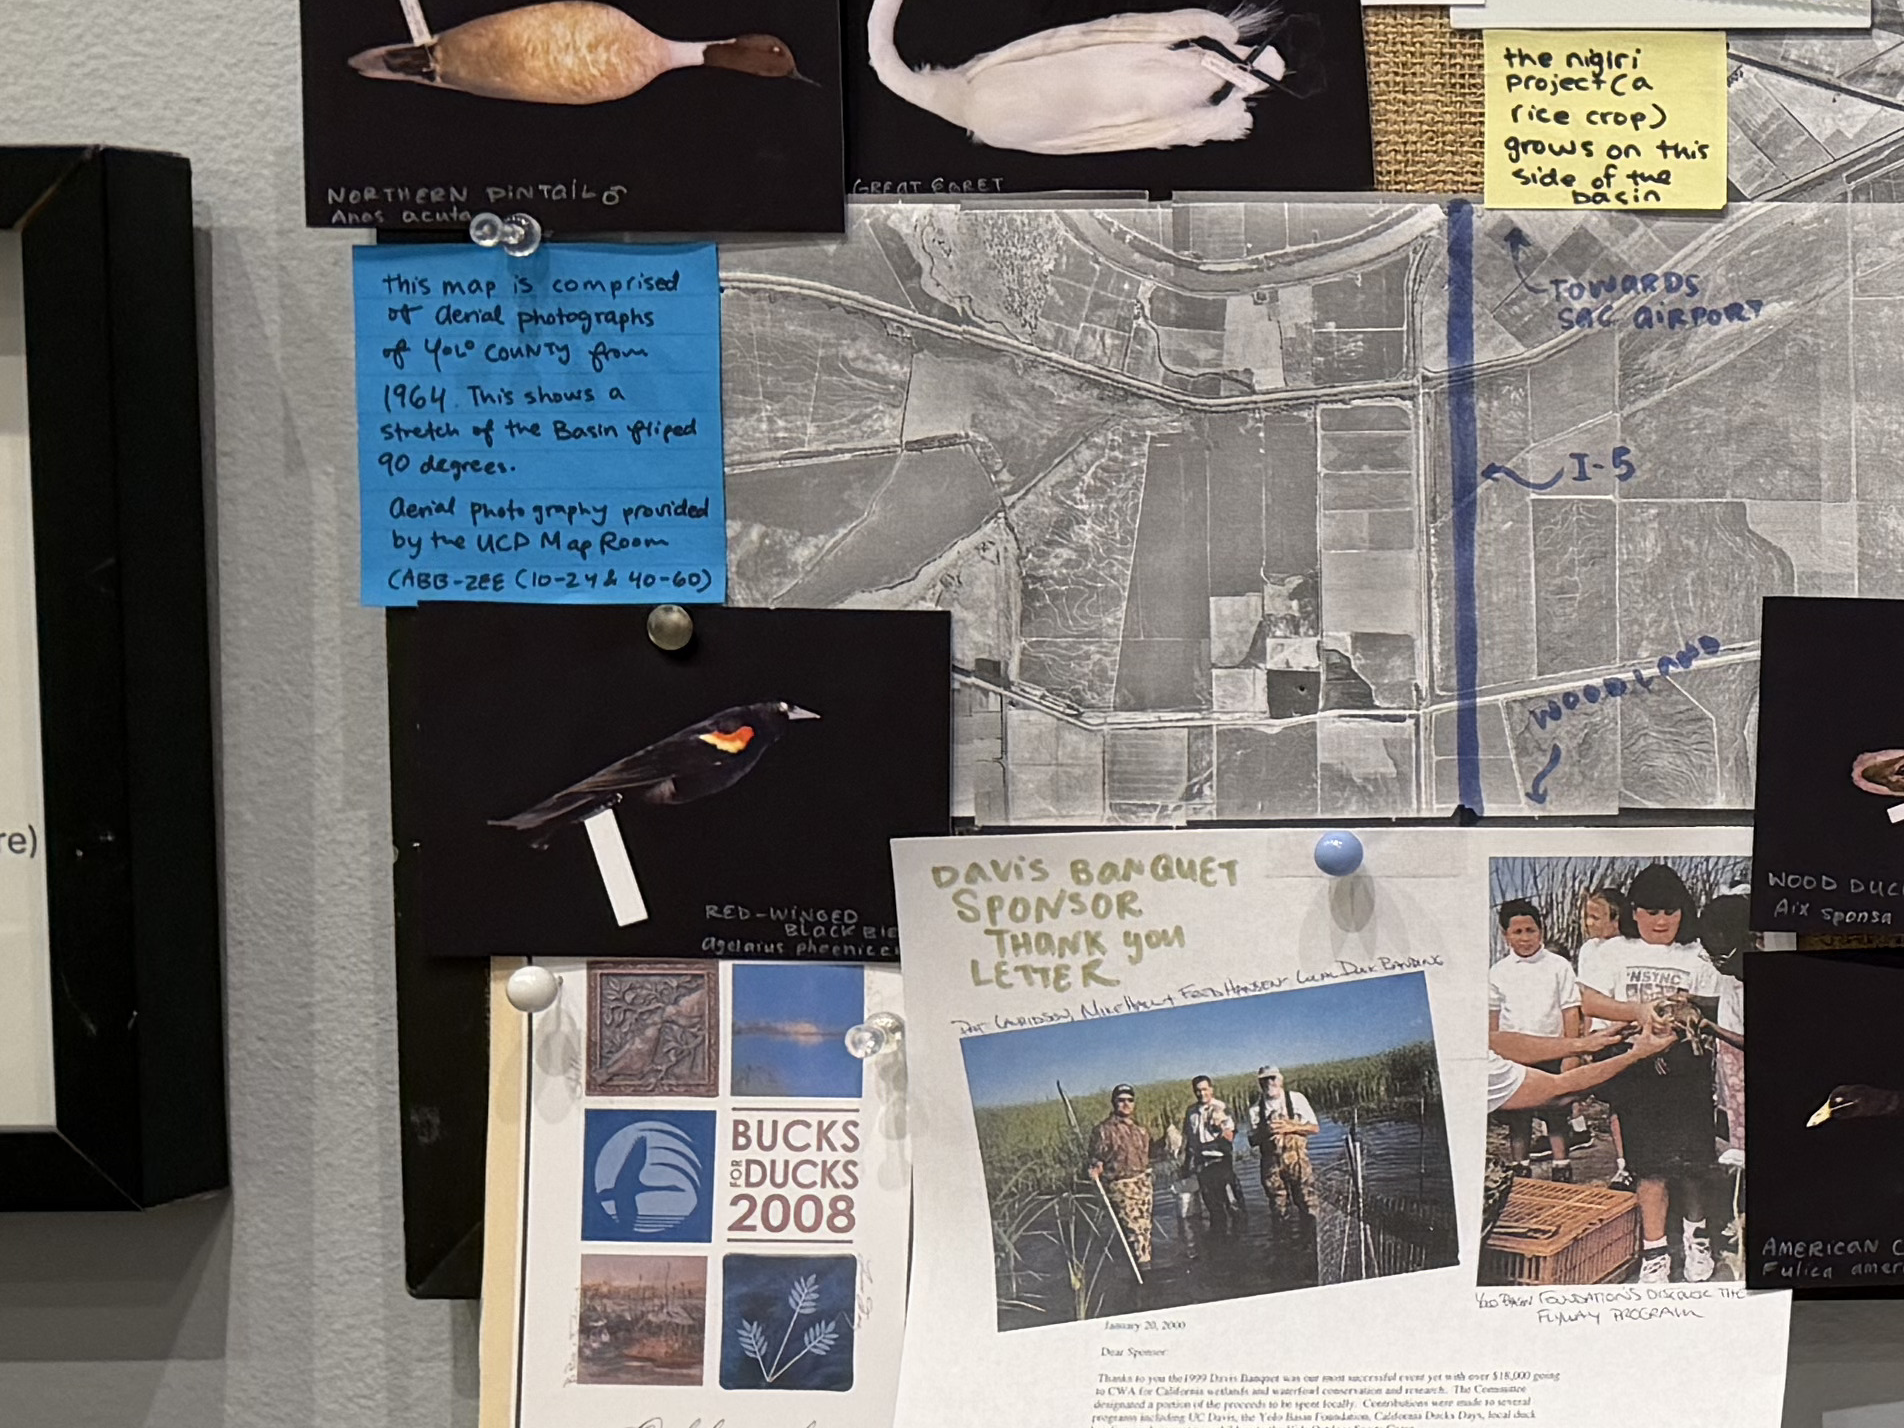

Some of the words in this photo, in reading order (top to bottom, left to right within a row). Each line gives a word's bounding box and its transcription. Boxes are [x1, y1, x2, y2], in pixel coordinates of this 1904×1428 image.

[732, 1119, 860, 1153] BUCKS
[730, 1160, 742, 1187] FOR
[745, 1159, 858, 1189] DUCKS
[727, 1194, 855, 1233] 2008
